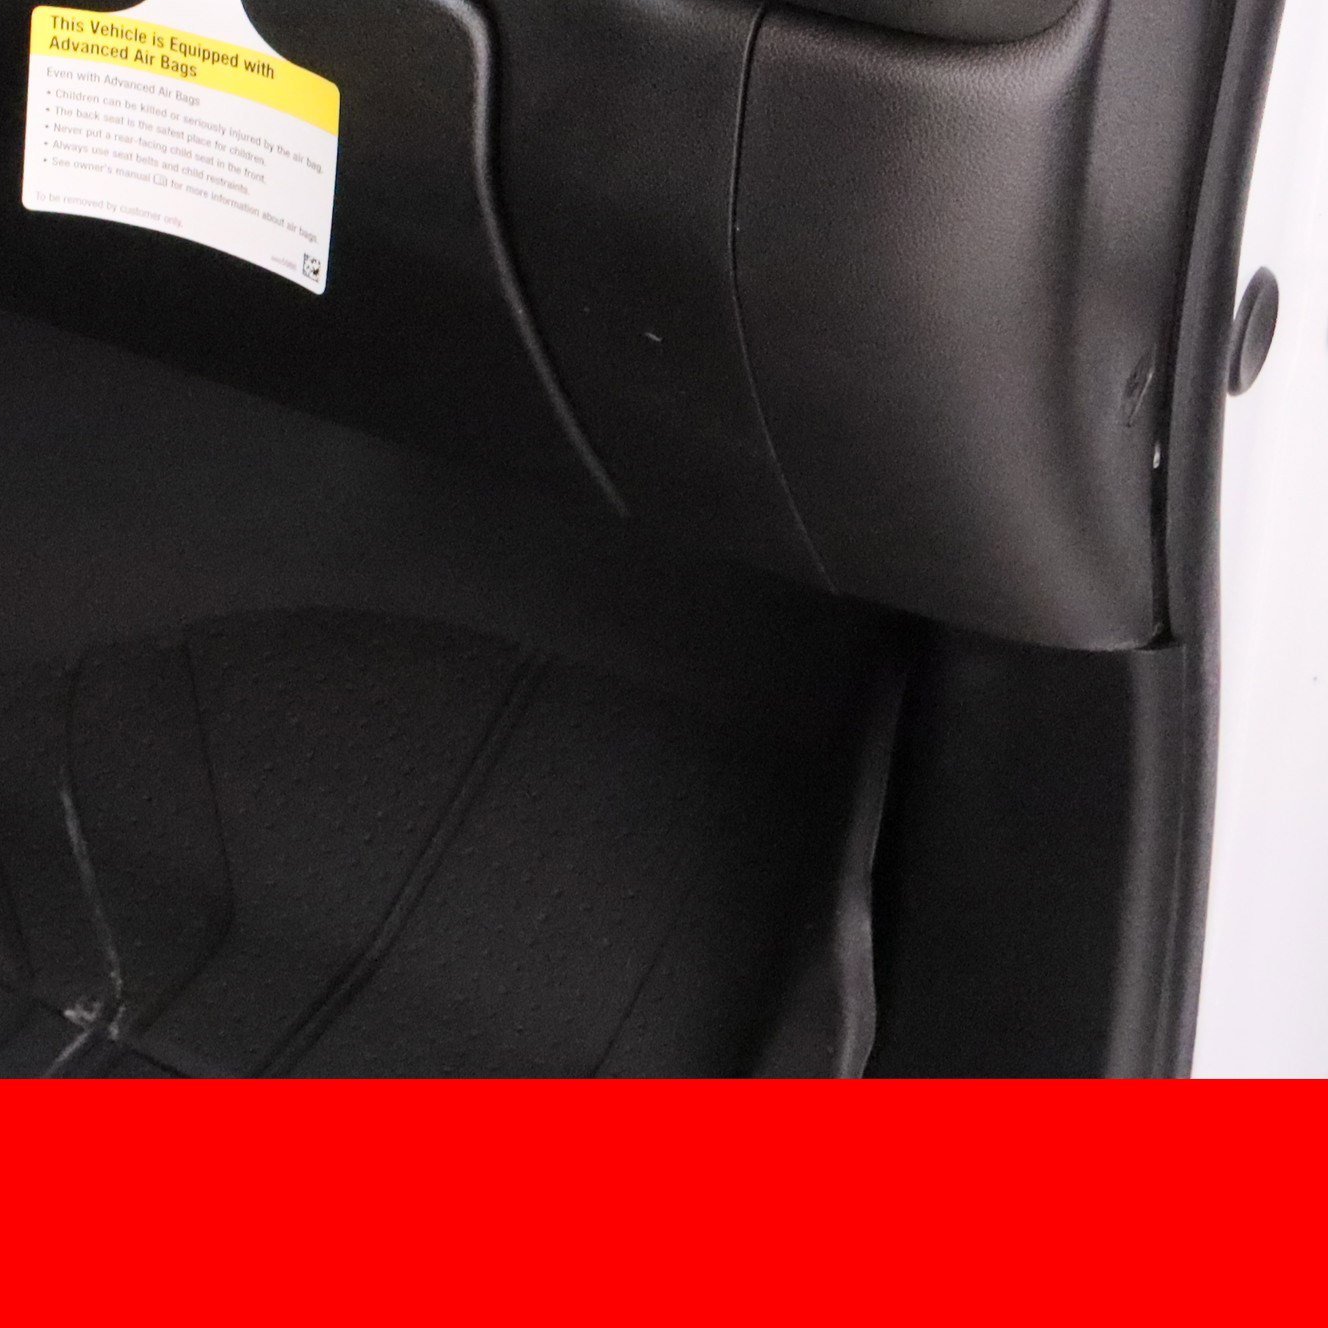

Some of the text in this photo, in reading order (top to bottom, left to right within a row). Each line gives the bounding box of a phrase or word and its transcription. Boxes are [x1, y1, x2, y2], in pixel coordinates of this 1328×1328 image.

[49, 35, 198, 79] Advanced Air Bags
[51, 15, 275, 80] This Vehicle is Equipped with
[46, 67, 201, 107] Even with Advanced Air Bags
[53, 122, 83, 136] Never
[86, 128, 104, 140] put
[170, 145, 194, 161] child
[195, 151, 215, 166] seat
[227, 160, 243, 175] the
[55, 88, 100, 104] Children
[103, 97, 122, 108] can
[124, 100, 137, 111] be
[140, 102, 168, 118] killed
[170, 110, 180, 121] or
[183, 114, 226, 136] seriously
[229, 126, 261, 147] injured
[263, 138, 275, 153] by
[276, 143, 291, 159] the
[293, 152, 304, 165] air
[55, 105, 74, 117] The
[76, 107, 100, 120] back
[103, 113, 125, 126] seat
[138, 119, 154, 132] the
[156, 124, 185, 140] safest
[186, 131, 213, 149] place
[214, 139, 227, 152] for
[53, 139, 89, 154] Always
[112, 149, 134, 162] seat
[135, 152, 160, 168] belts
[161, 159, 180, 173] and
[211, 191, 260, 218] information
[261, 211, 285, 229] about
[286, 221, 297, 234] air
